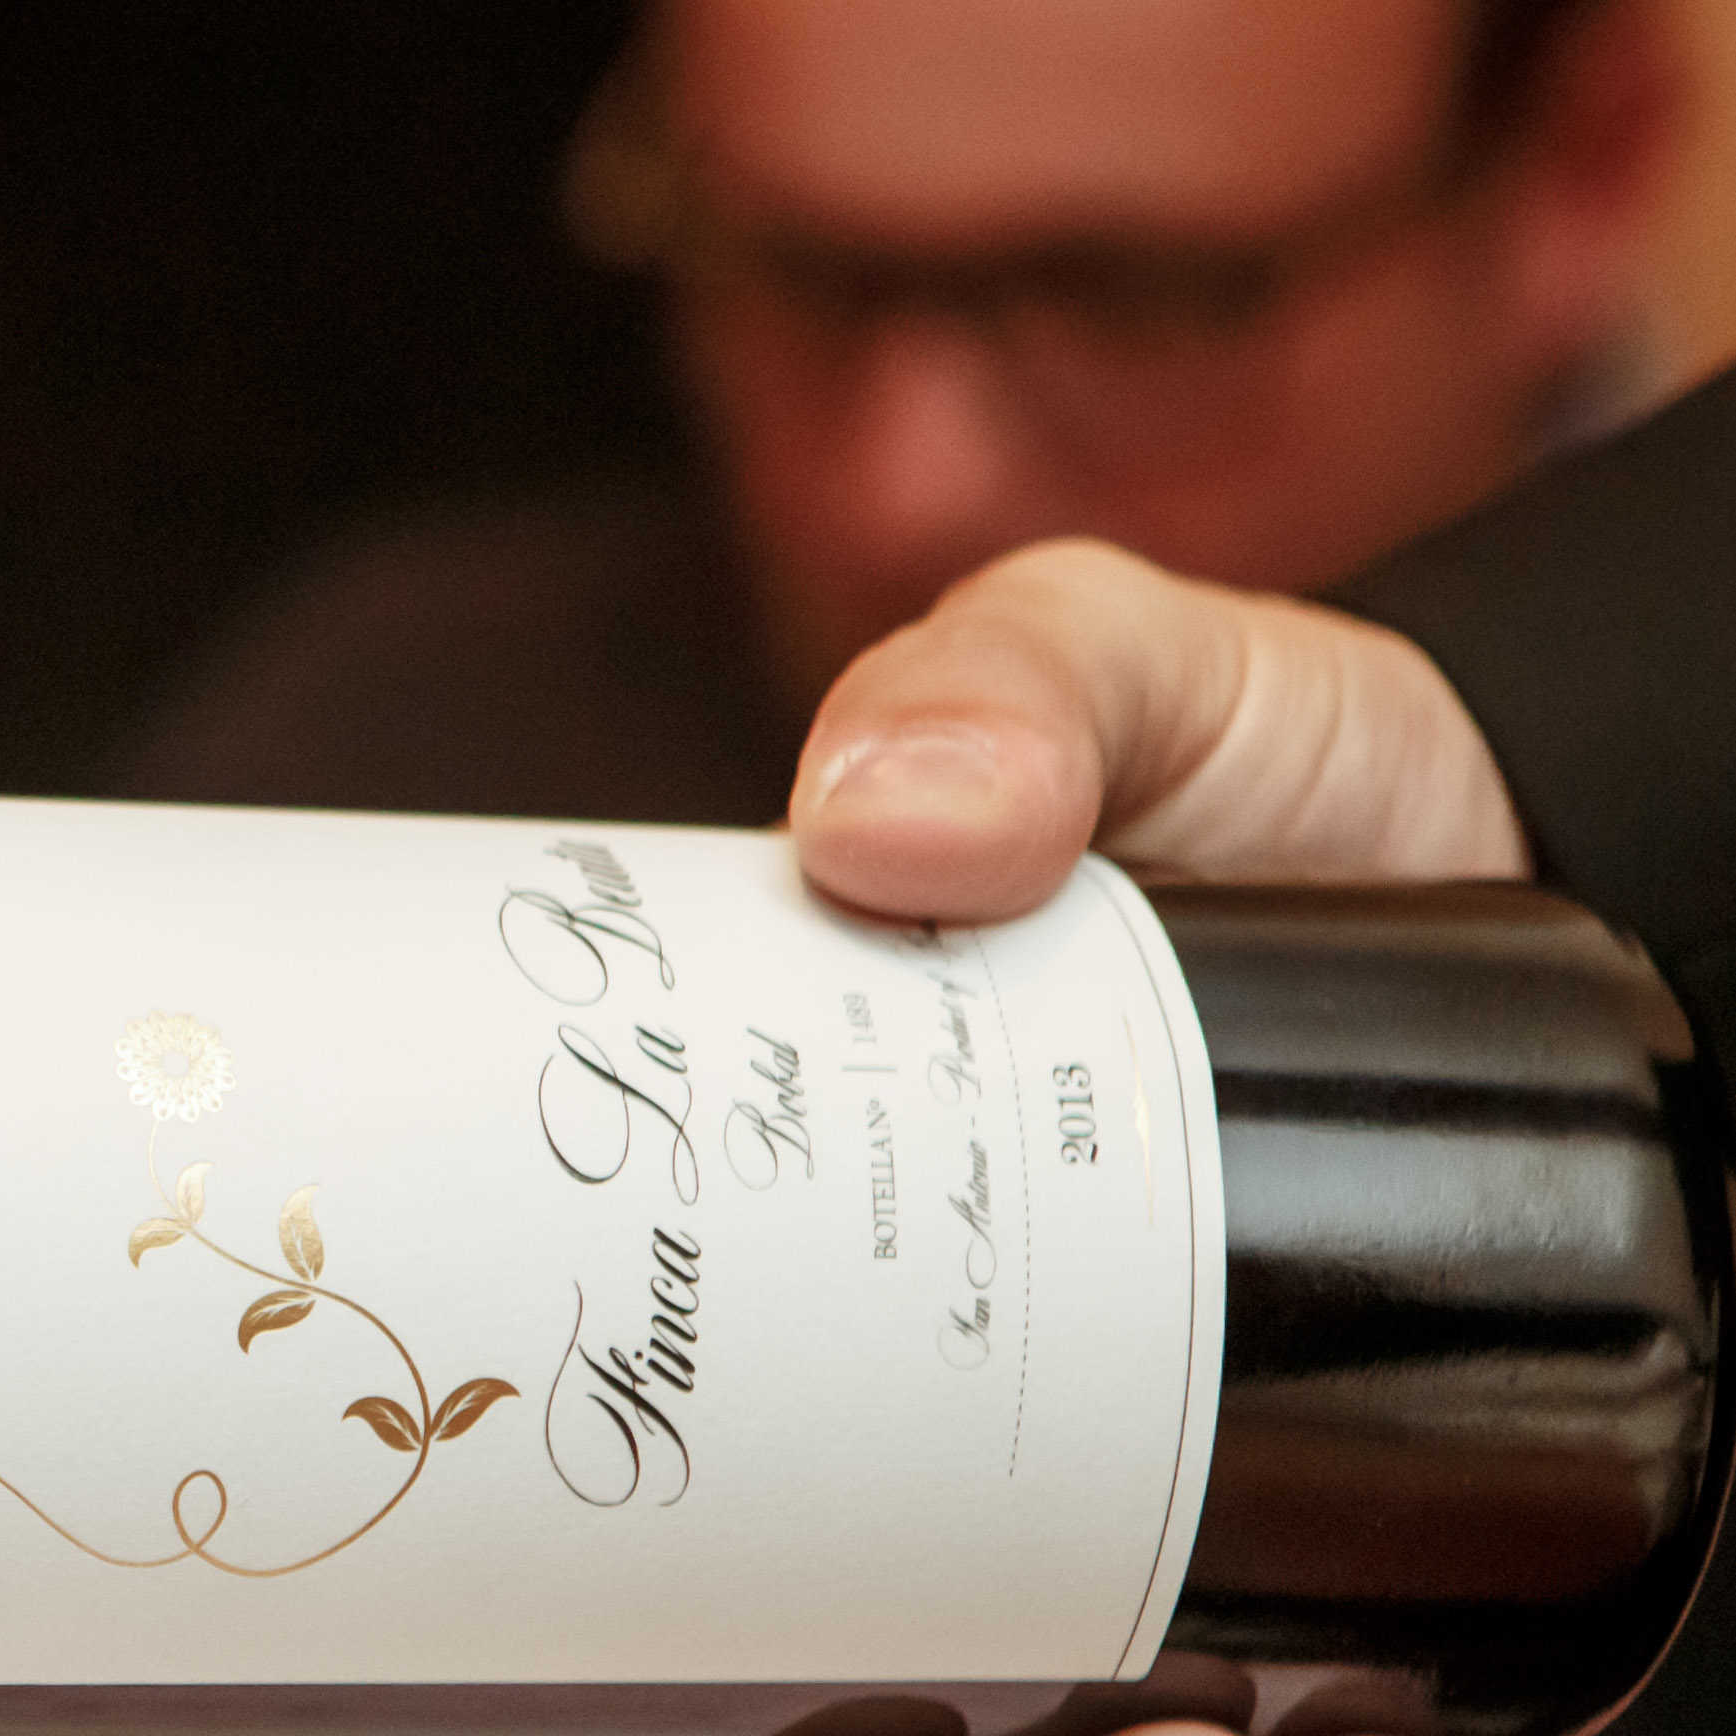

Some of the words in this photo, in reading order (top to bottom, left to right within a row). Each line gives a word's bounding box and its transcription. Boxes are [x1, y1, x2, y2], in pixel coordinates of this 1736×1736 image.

[538, 1023, 698, 1205] La
[724, 1027, 814, 1190] Bobal
[1051, 1061, 1099, 1164] 2013
[871, 1134, 897, 1259] BOTELLA
[946, 1139, 997, 1289] Antonio
[546, 1227, 700, 1505] Finca
[937, 1298, 990, 1369] San
